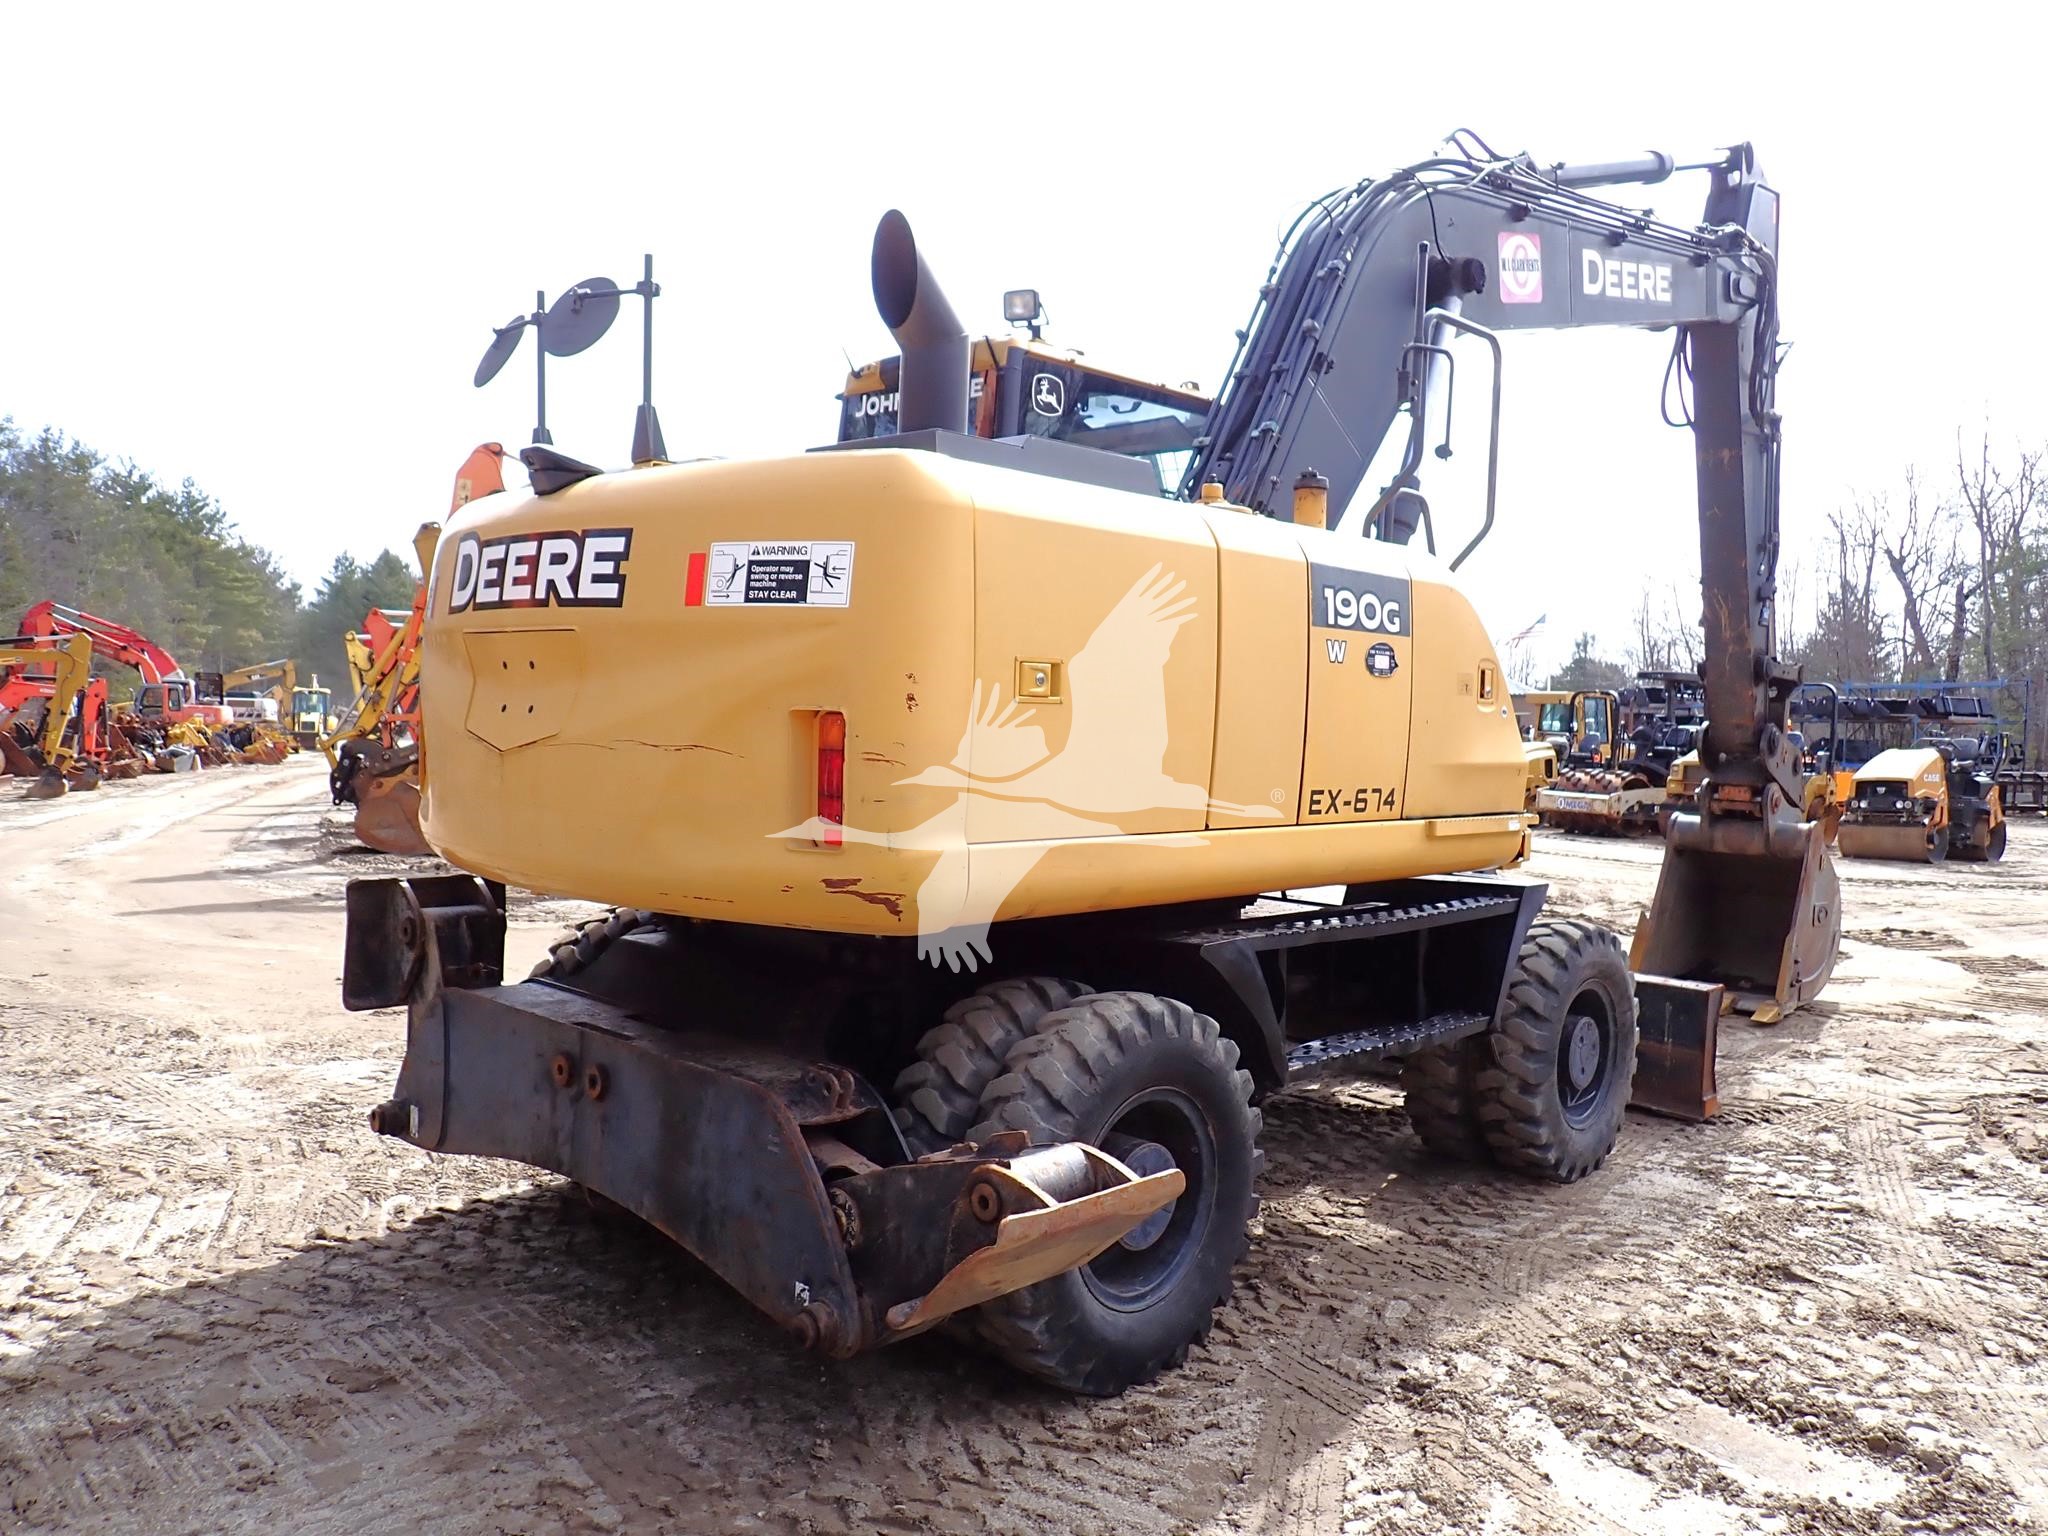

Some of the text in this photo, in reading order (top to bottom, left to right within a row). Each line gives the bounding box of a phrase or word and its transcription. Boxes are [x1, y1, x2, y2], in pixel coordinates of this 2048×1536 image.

[1582, 248, 1672, 302] DEERE
[761, 545, 808, 556] WARNING
[450, 535, 627, 608] DEERE
[750, 573, 769, 581] swing
[751, 565, 779, 573] Operator
[748, 590, 797, 598] STAY CLEAR
[1323, 586, 1400, 633] 190G
[1326, 639, 1347, 664] W
[1308, 788, 1396, 815] EX-674
